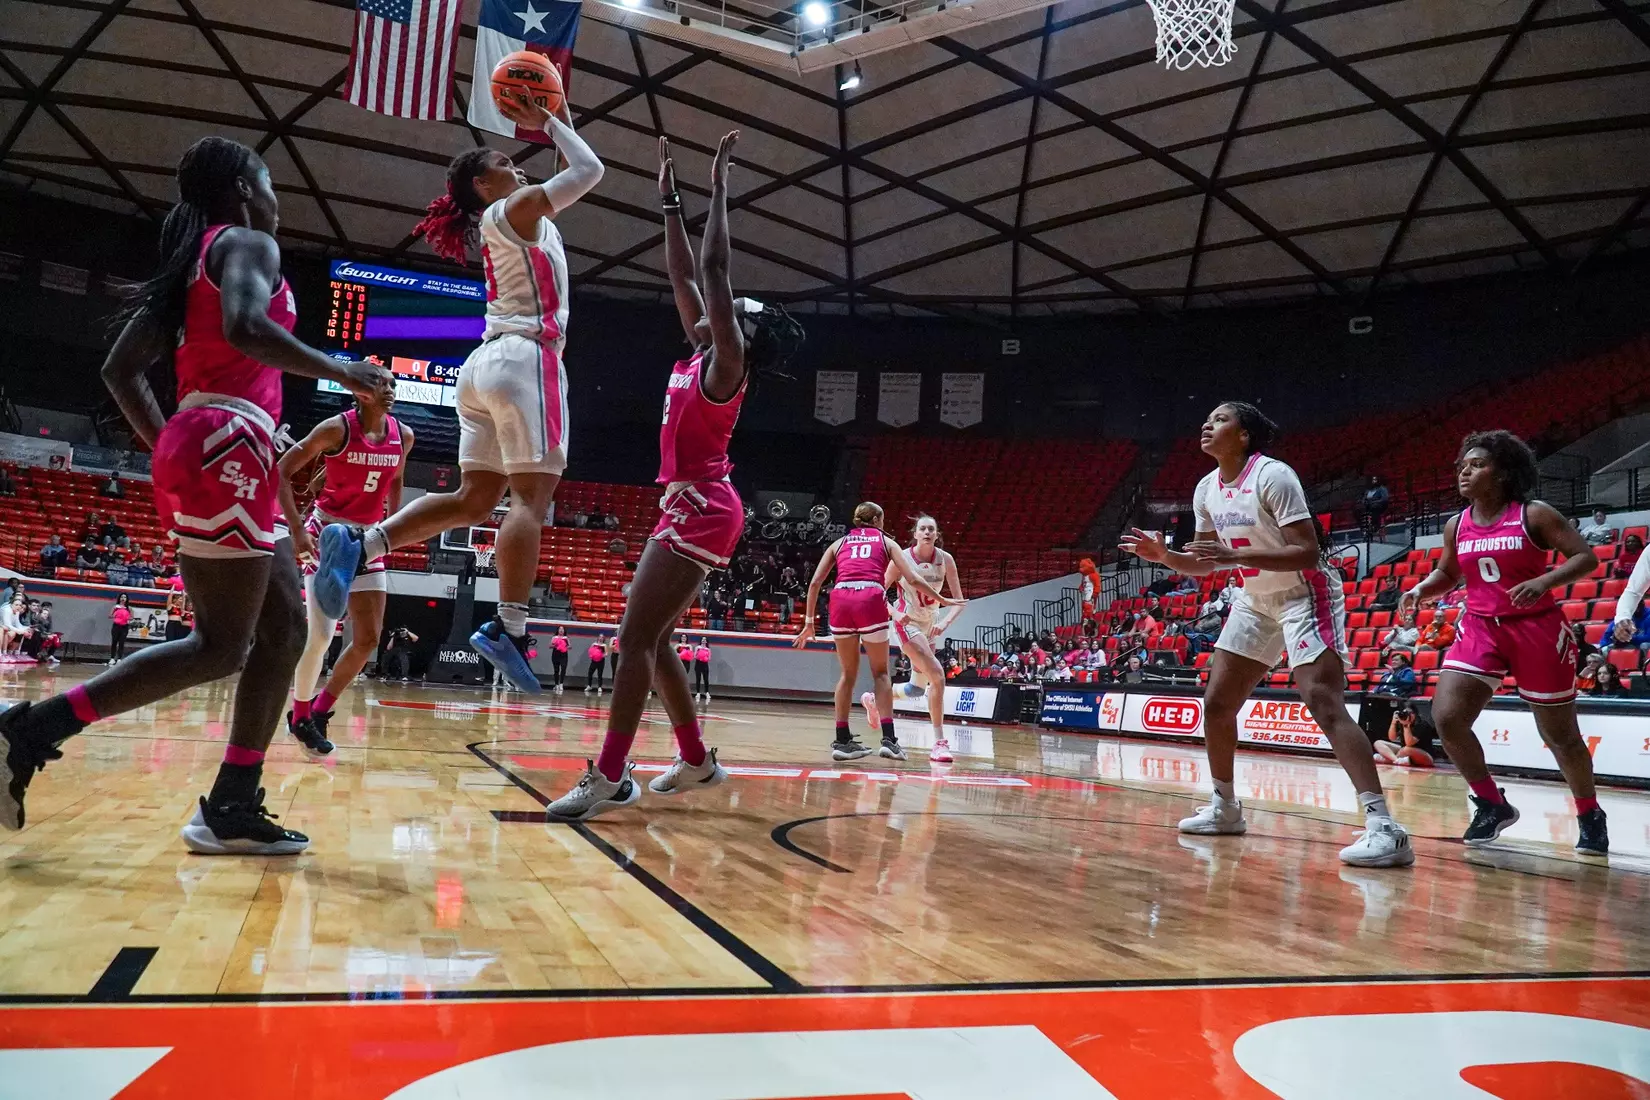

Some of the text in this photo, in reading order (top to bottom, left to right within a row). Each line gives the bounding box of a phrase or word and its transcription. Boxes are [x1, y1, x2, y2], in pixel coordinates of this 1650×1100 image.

[342, 267, 419, 286] BUD LIGHT
[330, 281, 365, 292] PLY FL PTS
[422, 284, 441, 292] DRINK
[334, 290, 365, 301] 0 0 0
[358, 303, 364, 311] 0
[332, 309, 363, 321] 5 0 0
[328, 319, 337, 327] 12
[343, 321, 350, 329] 0
[1348, 316, 1373, 334] C
[327, 328, 361, 341] 10 0 0
[1002, 340, 1020, 355] B
[412, 361, 420, 373] 0
[347, 451, 367, 466] SAM
[363, 470, 381, 493] 5
[1474, 536, 1523, 552] HOUSTON
[850, 544, 872, 559] 10
[1478, 557, 1501, 583] 0
[439, 656, 480, 664] HERMANN
[440, 650, 480, 659] MEMORIAL
[960, 690, 975, 701] BUD
[1045, 694, 1053, 702] The
[1053, 695, 1068, 703] Official
[955, 701, 976, 713] LIGHT
[1044, 704, 1060, 712] provider
[1075, 704, 1093, 713] Athletics
[1245, 720, 1268, 729] SIGNS
[1268, 721, 1274, 729] &
[1275, 722, 1314, 732] LIGHTING,
[1251, 731, 1320, 746] 936.435.9966
